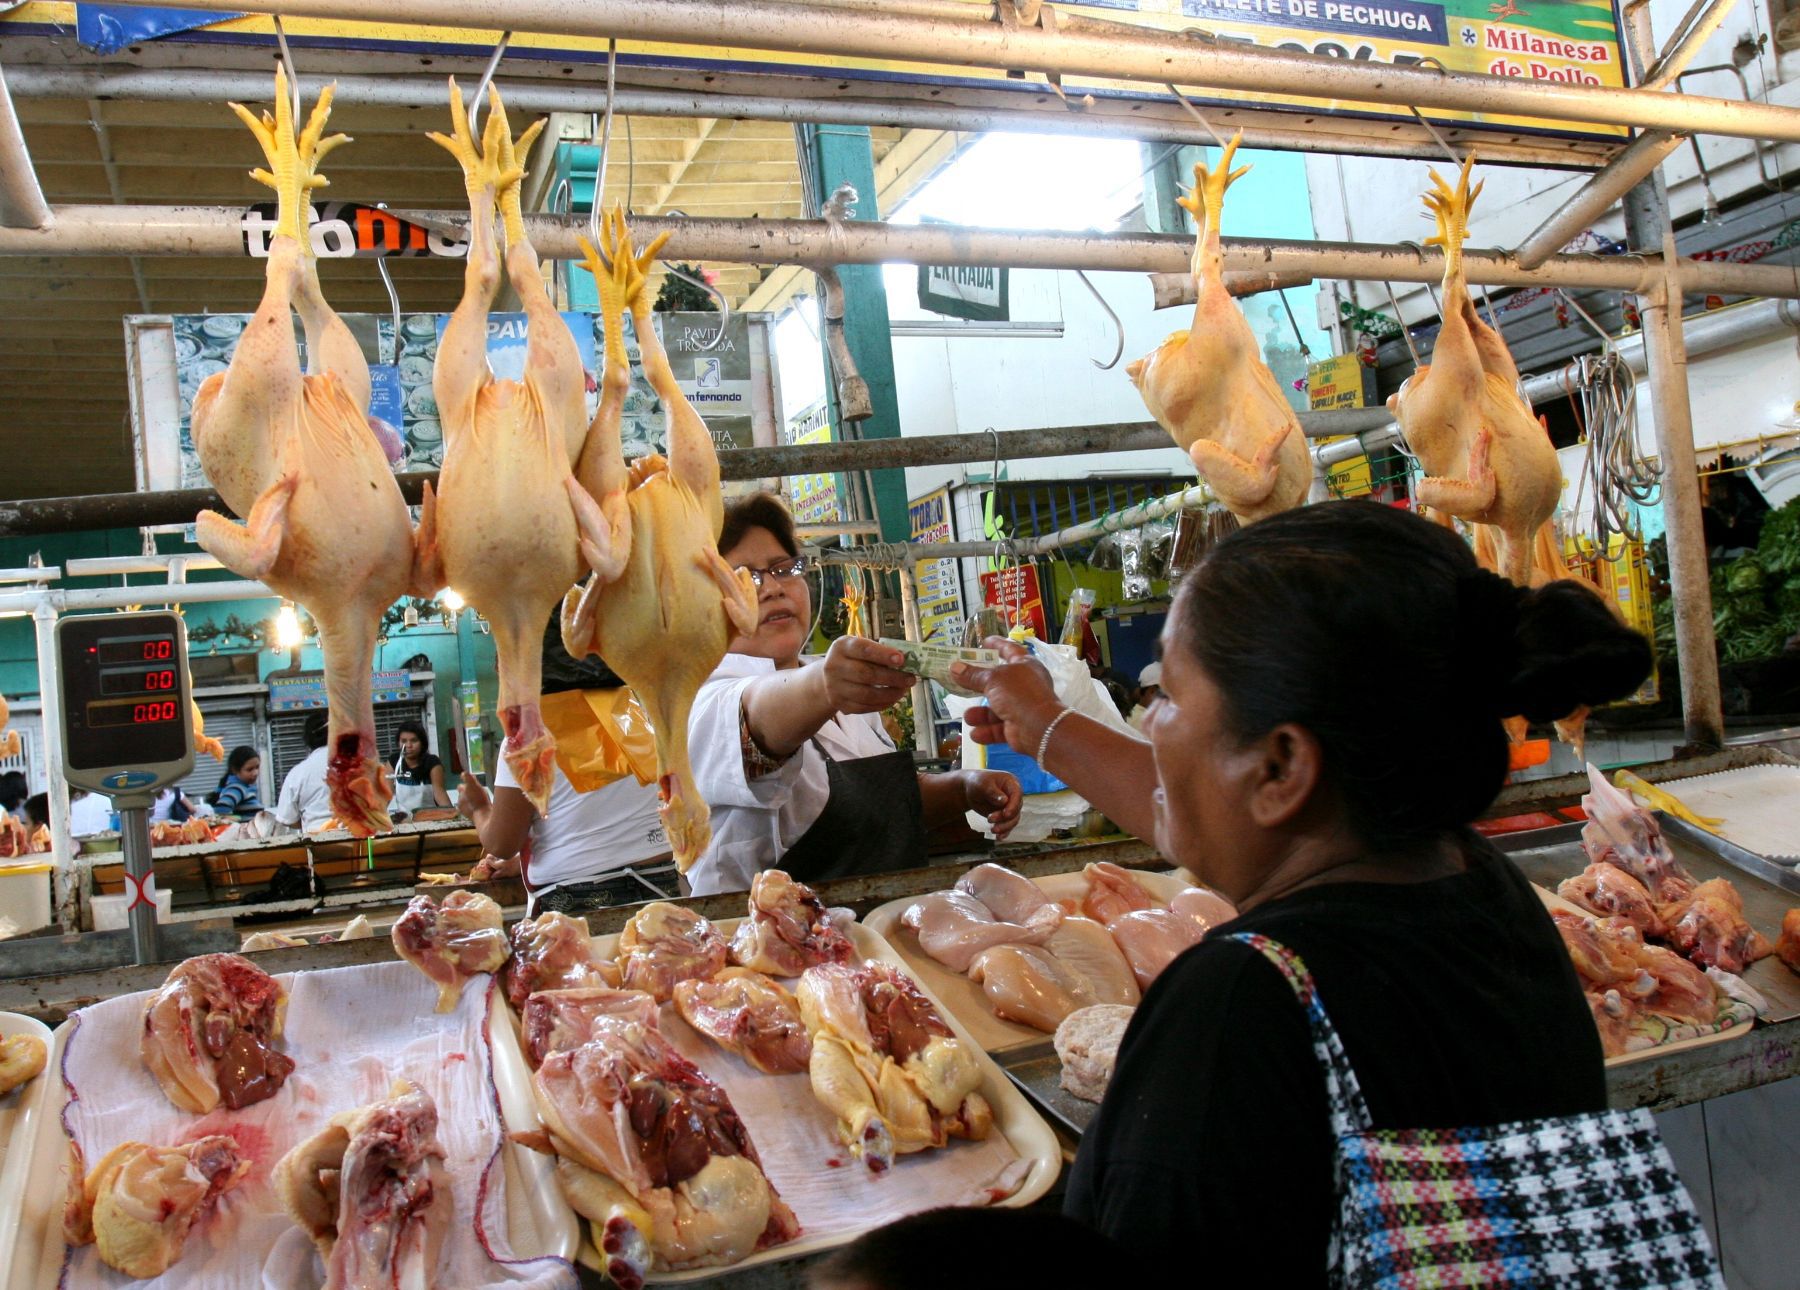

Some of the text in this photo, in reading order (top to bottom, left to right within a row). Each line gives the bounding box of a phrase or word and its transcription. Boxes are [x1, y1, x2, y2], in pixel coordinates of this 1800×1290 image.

[1289, 1, 1318, 19] DE
[1326, 3, 1433, 32] PECHUGA
[1487, 28, 1608, 61] Milanesa
[1491, 60, 1600, 86] de Pollo
[684, 326, 728, 340] PAVIT
[676, 339, 736, 352] TROZDA
[696, 391, 742, 401] fernando
